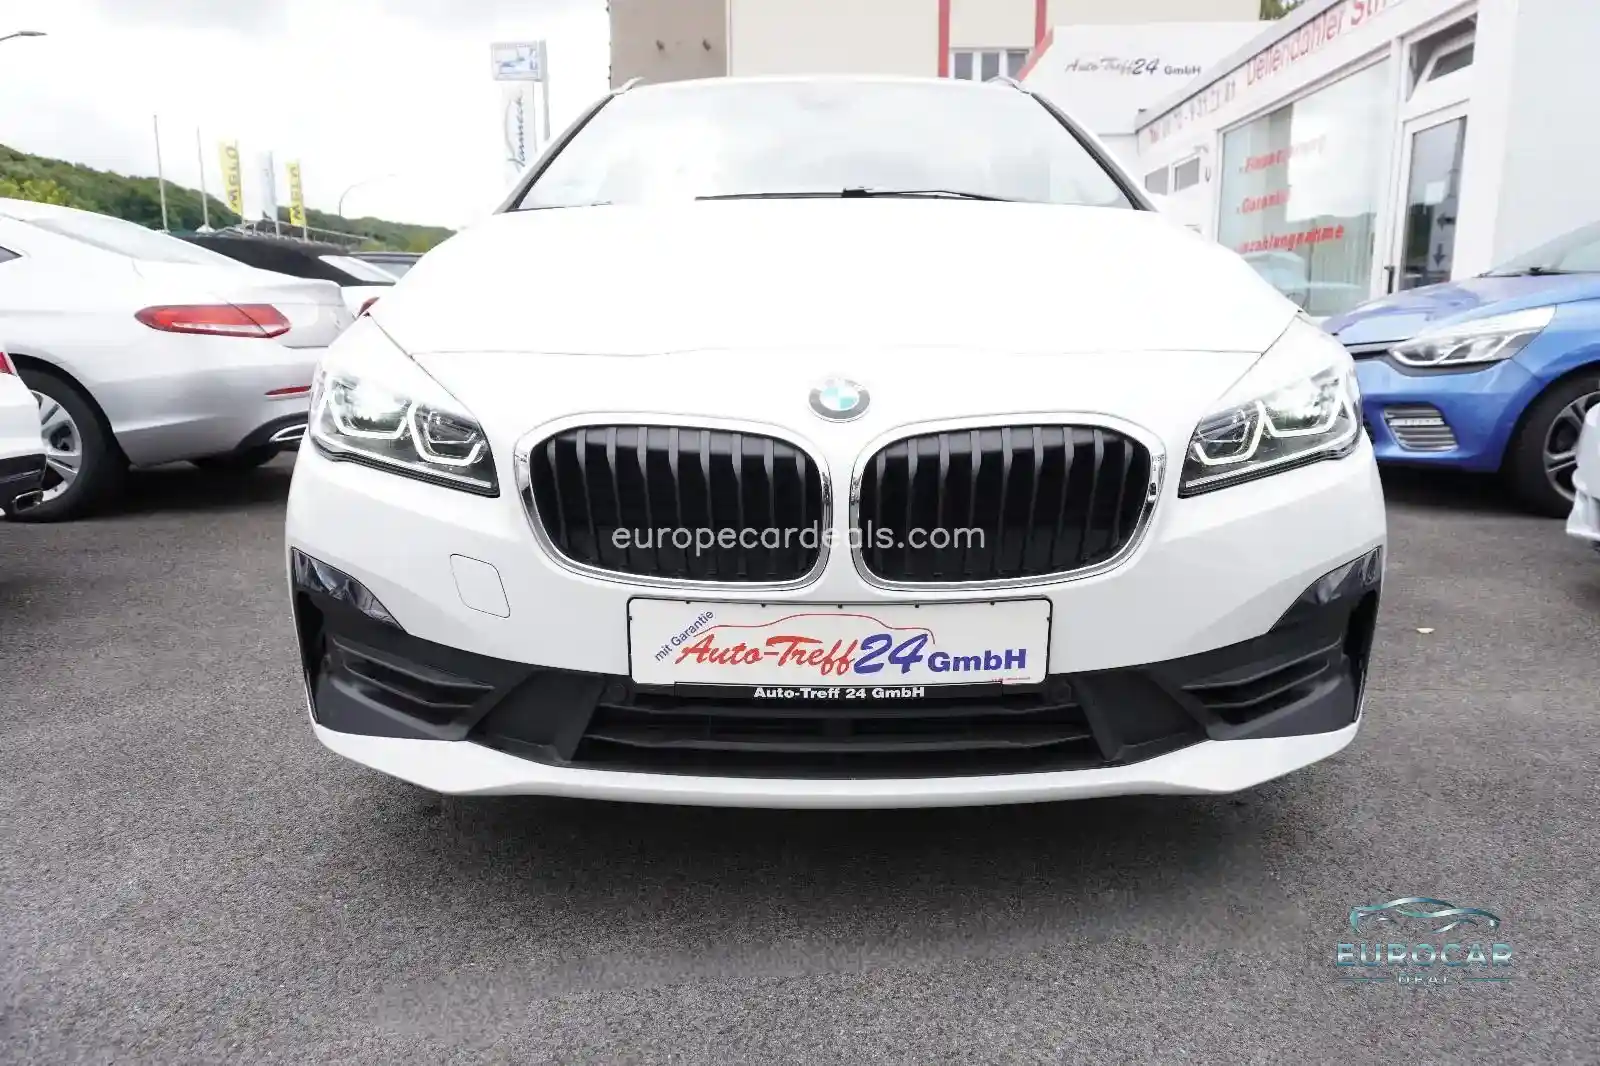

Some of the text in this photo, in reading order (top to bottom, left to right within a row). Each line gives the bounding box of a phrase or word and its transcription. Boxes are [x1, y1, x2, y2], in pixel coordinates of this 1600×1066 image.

[1164, 65, 1202, 75] GmbH
[655, 611, 714, 661] mit Garantie
[928, 648, 1027, 673] GmbH
[753, 687, 925, 699] Auto-Treff 24 GmbH
